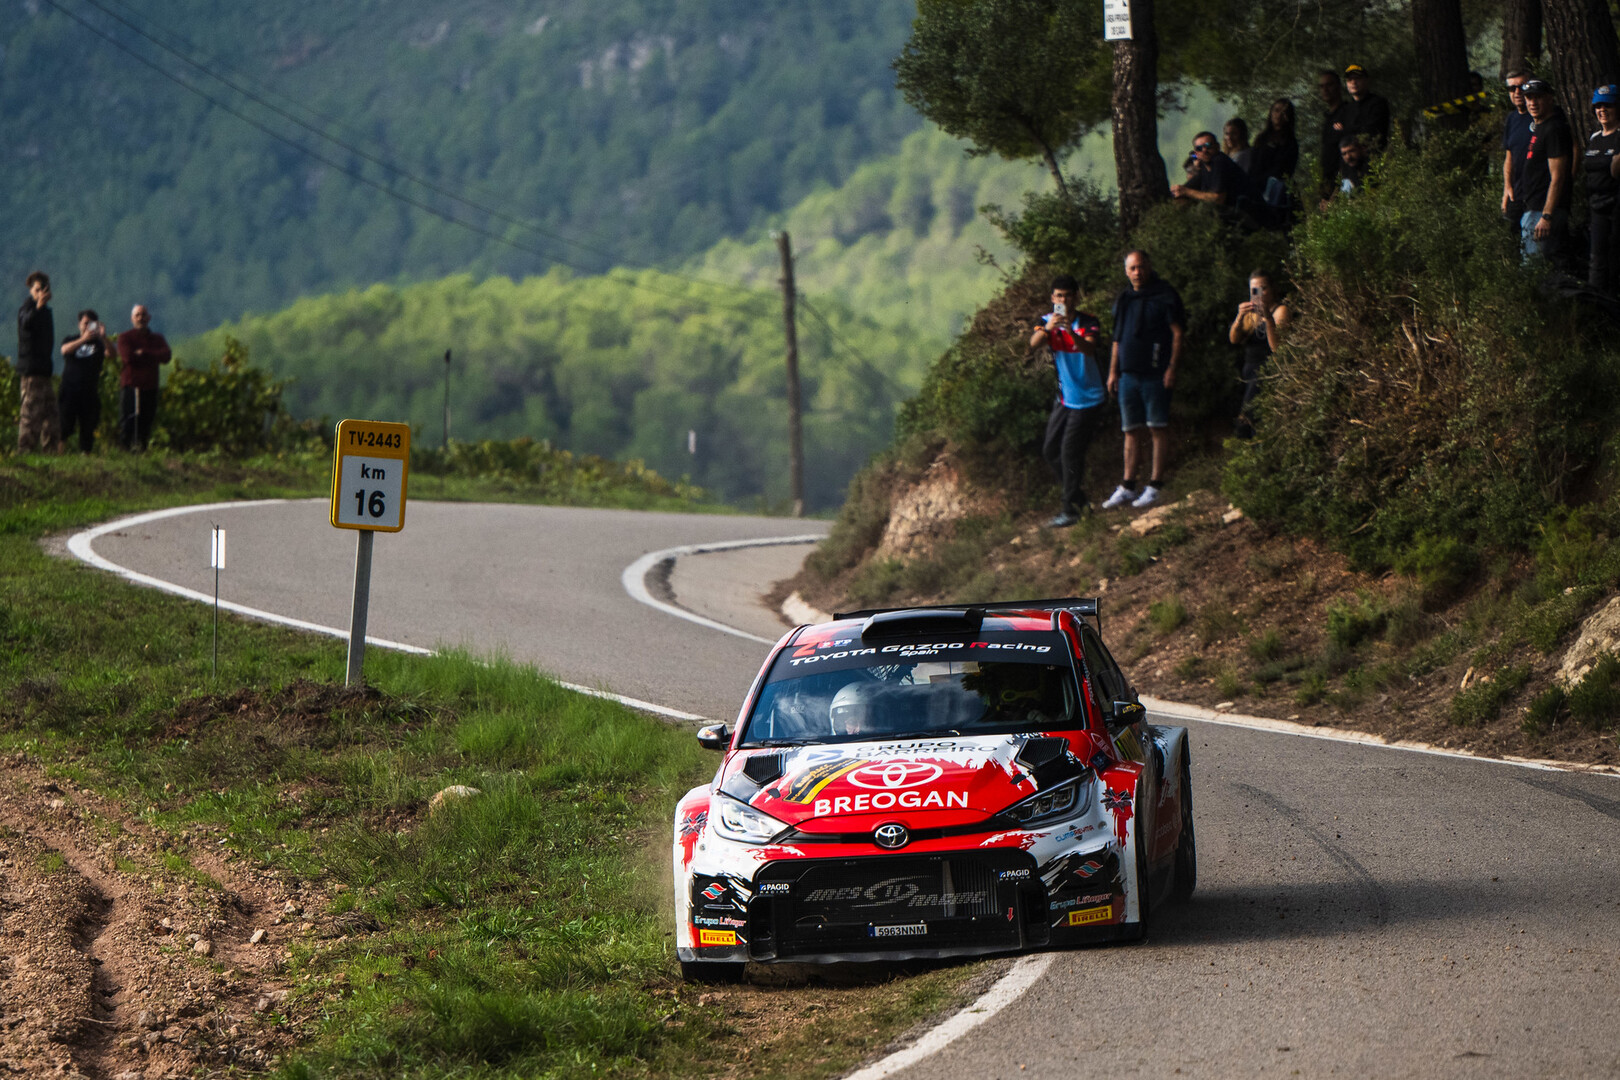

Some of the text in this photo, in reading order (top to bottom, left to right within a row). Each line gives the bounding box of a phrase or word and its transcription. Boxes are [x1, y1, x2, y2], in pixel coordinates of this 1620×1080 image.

[349, 431, 401, 448] TV-2443
[361, 463, 385, 480] km
[355, 489, 385, 518] 16
[790, 642, 1051, 666] TOYOTA GAZOO Racing
[899, 649, 939, 657] Spain
[814, 791, 968, 816] BREOGAN
[1006, 869, 1030, 877] PAGID
[767, 883, 790, 891] PAGID
[1072, 908, 1108, 923] PIRELLI
[703, 932, 734, 943] PIRELLI
[878, 926, 925, 936] 5963NNM
